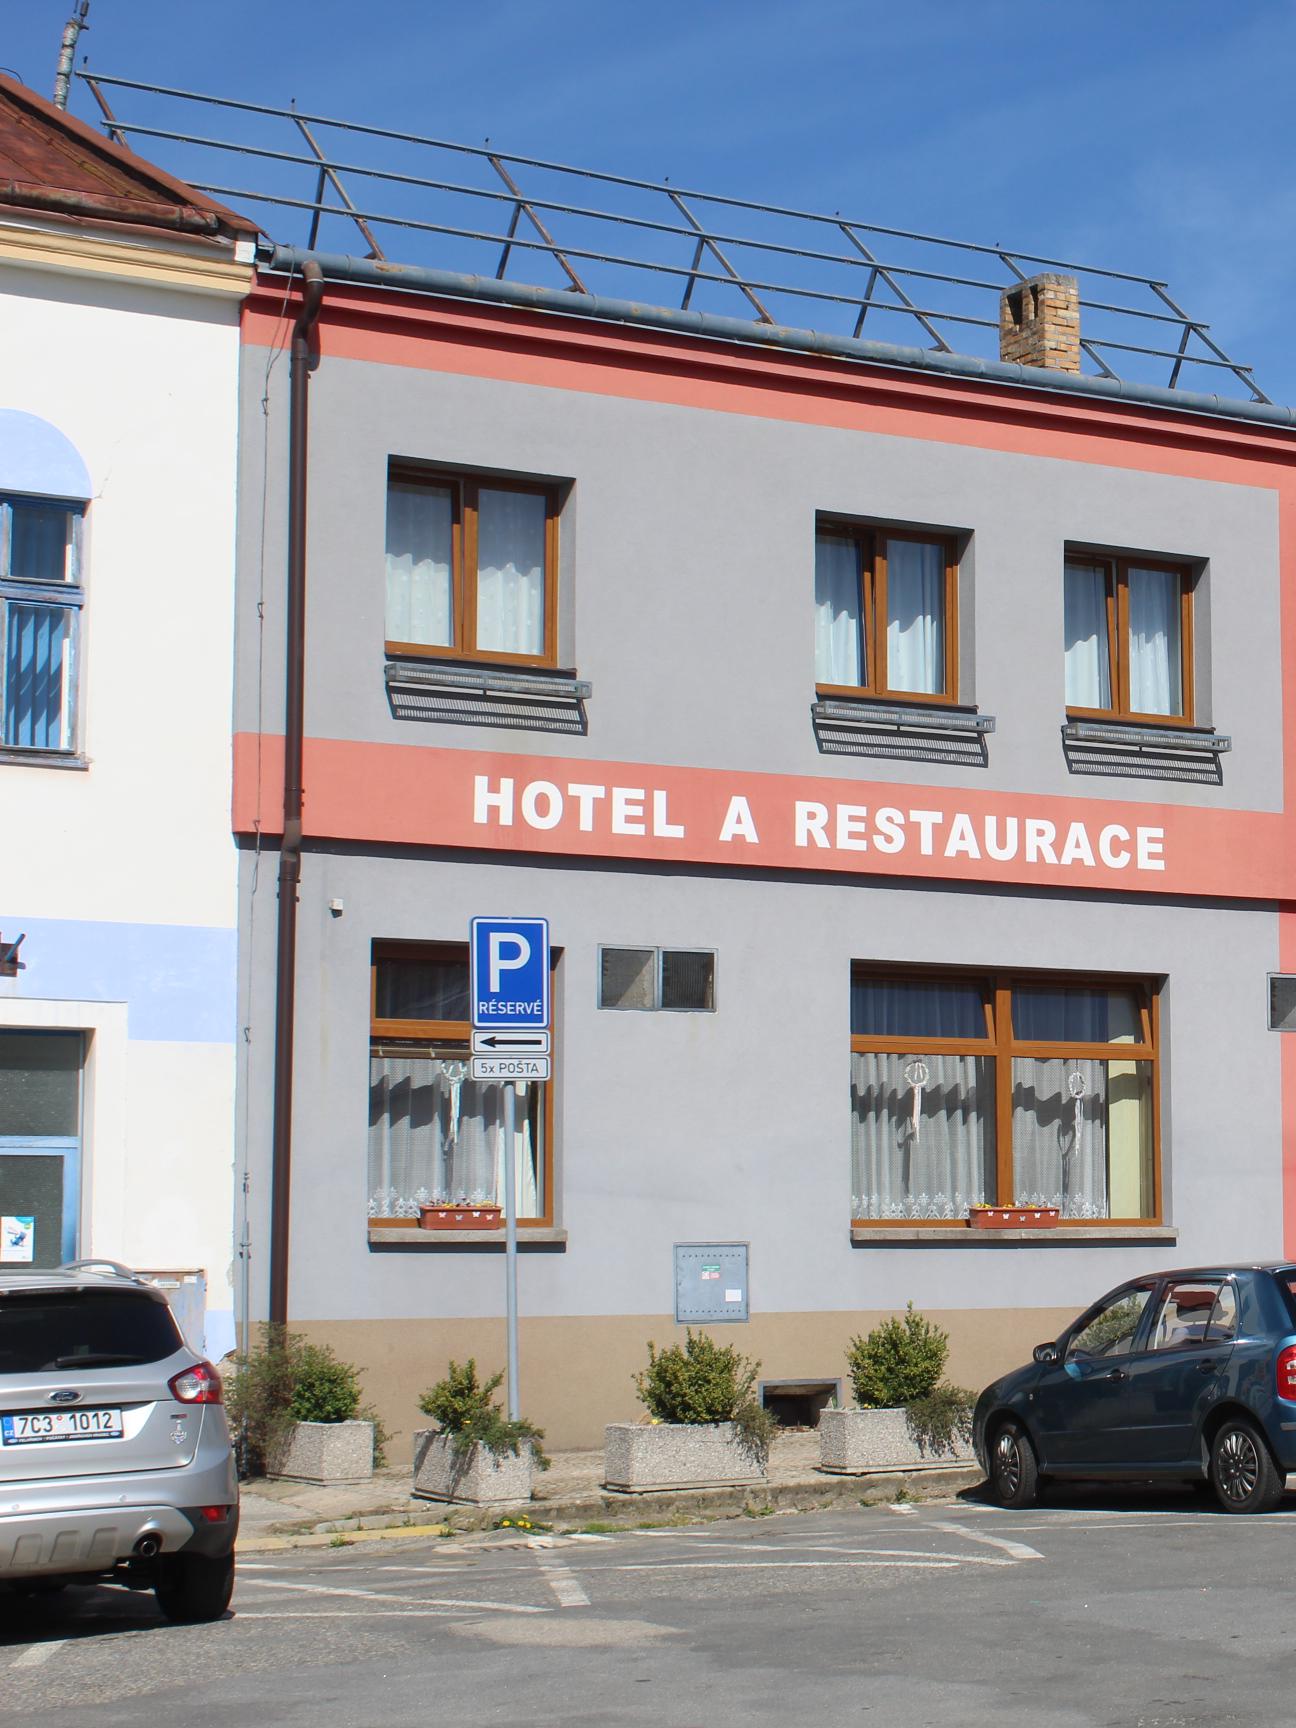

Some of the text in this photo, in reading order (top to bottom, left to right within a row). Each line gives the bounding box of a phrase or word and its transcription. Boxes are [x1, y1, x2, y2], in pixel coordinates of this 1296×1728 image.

[473, 775, 1165, 871] HOTEL A RESTAURACE
[489, 932, 531, 992] P
[479, 999, 542, 1014] RÉSERVÉ
[480, 1061, 539, 1073] 5x POŠTA
[18, 1416, 53, 1435] 7C3
[69, 1412, 113, 1431] 1012
